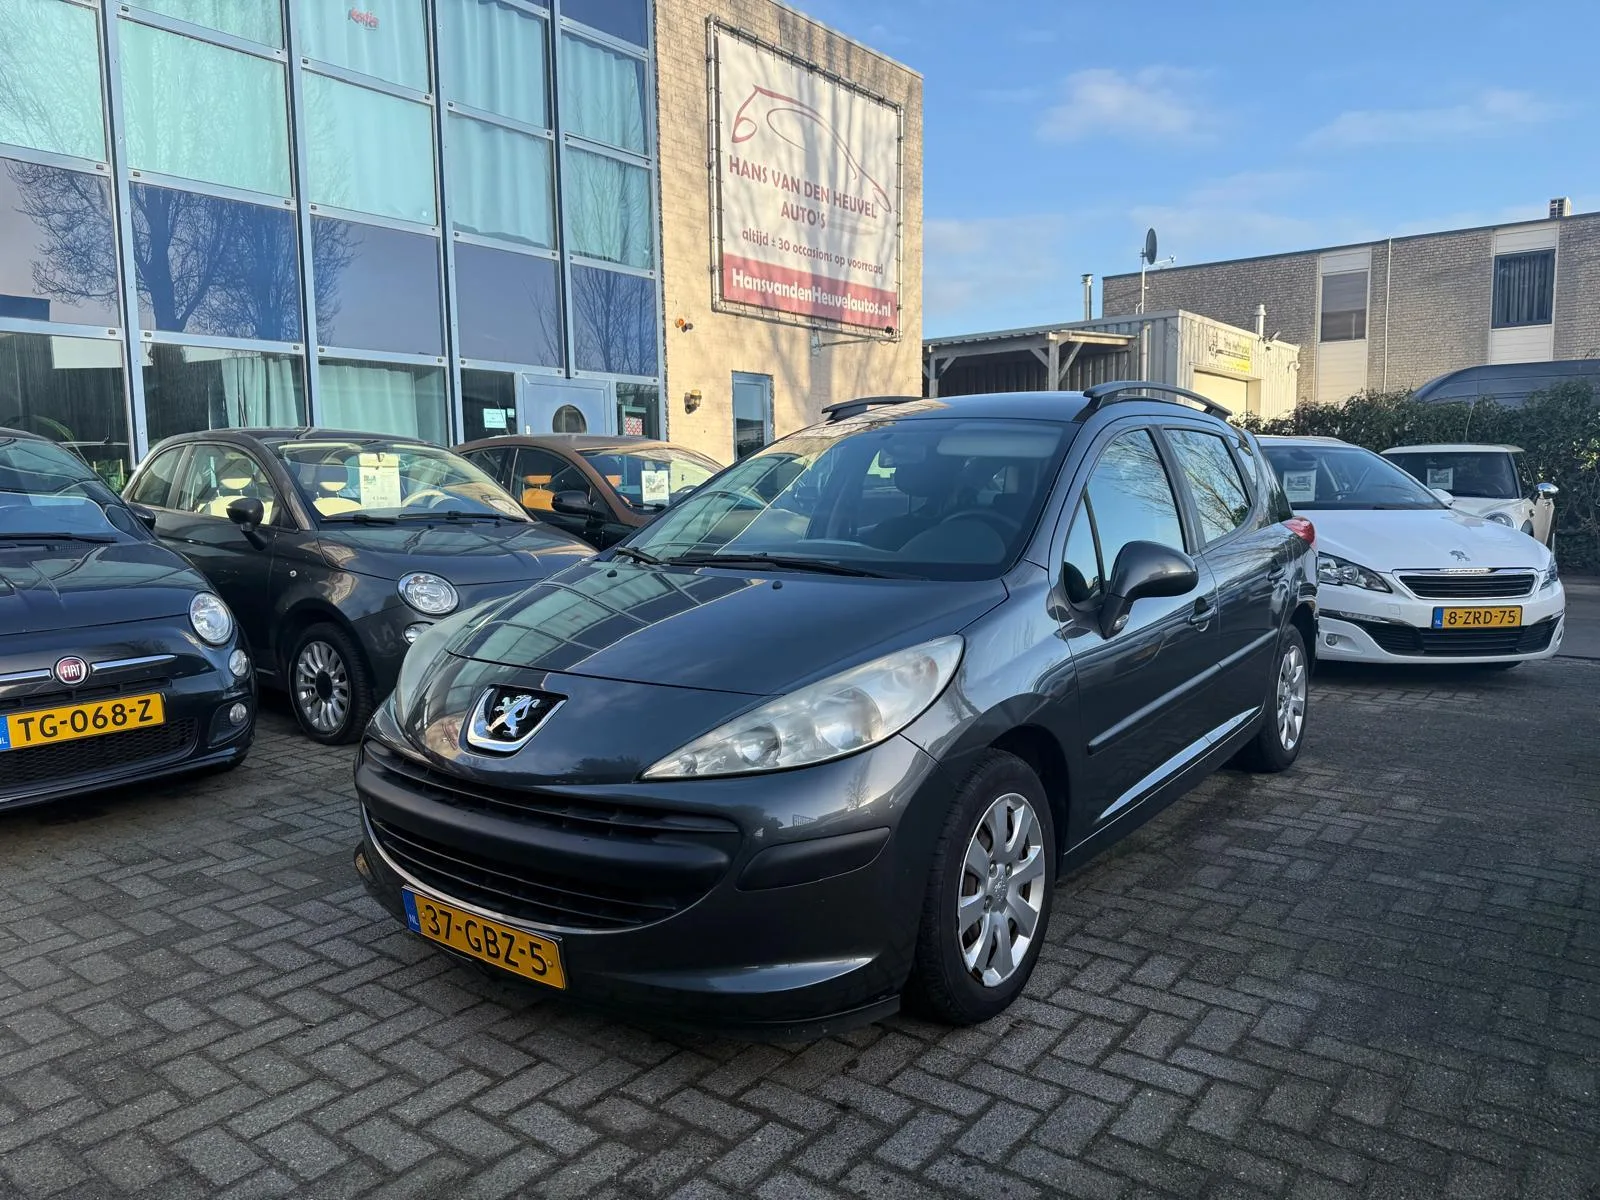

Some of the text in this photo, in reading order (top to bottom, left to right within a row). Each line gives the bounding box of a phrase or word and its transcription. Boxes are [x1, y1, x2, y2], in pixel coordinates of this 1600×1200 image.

[729, 155, 877, 219] HANS VAN DEN HEUVEL
[781, 201, 826, 229] AUTO'S
[742, 227, 769, 247] altijd
[778, 237, 790, 252] 30
[792, 243, 833, 263] occasions
[834, 254, 846, 268] op
[847, 258, 884, 275] voorraad
[732, 268, 891, 317] HansvandenHeuvelautos.nl
[1447, 610, 1516, 625] 8-ZRD-75
[63, 663, 81, 678] FIAT
[17, 699, 153, 741] TG-068-Z
[408, 913, 420, 926] NL
[425, 904, 548, 976] 37-GBZ-5
